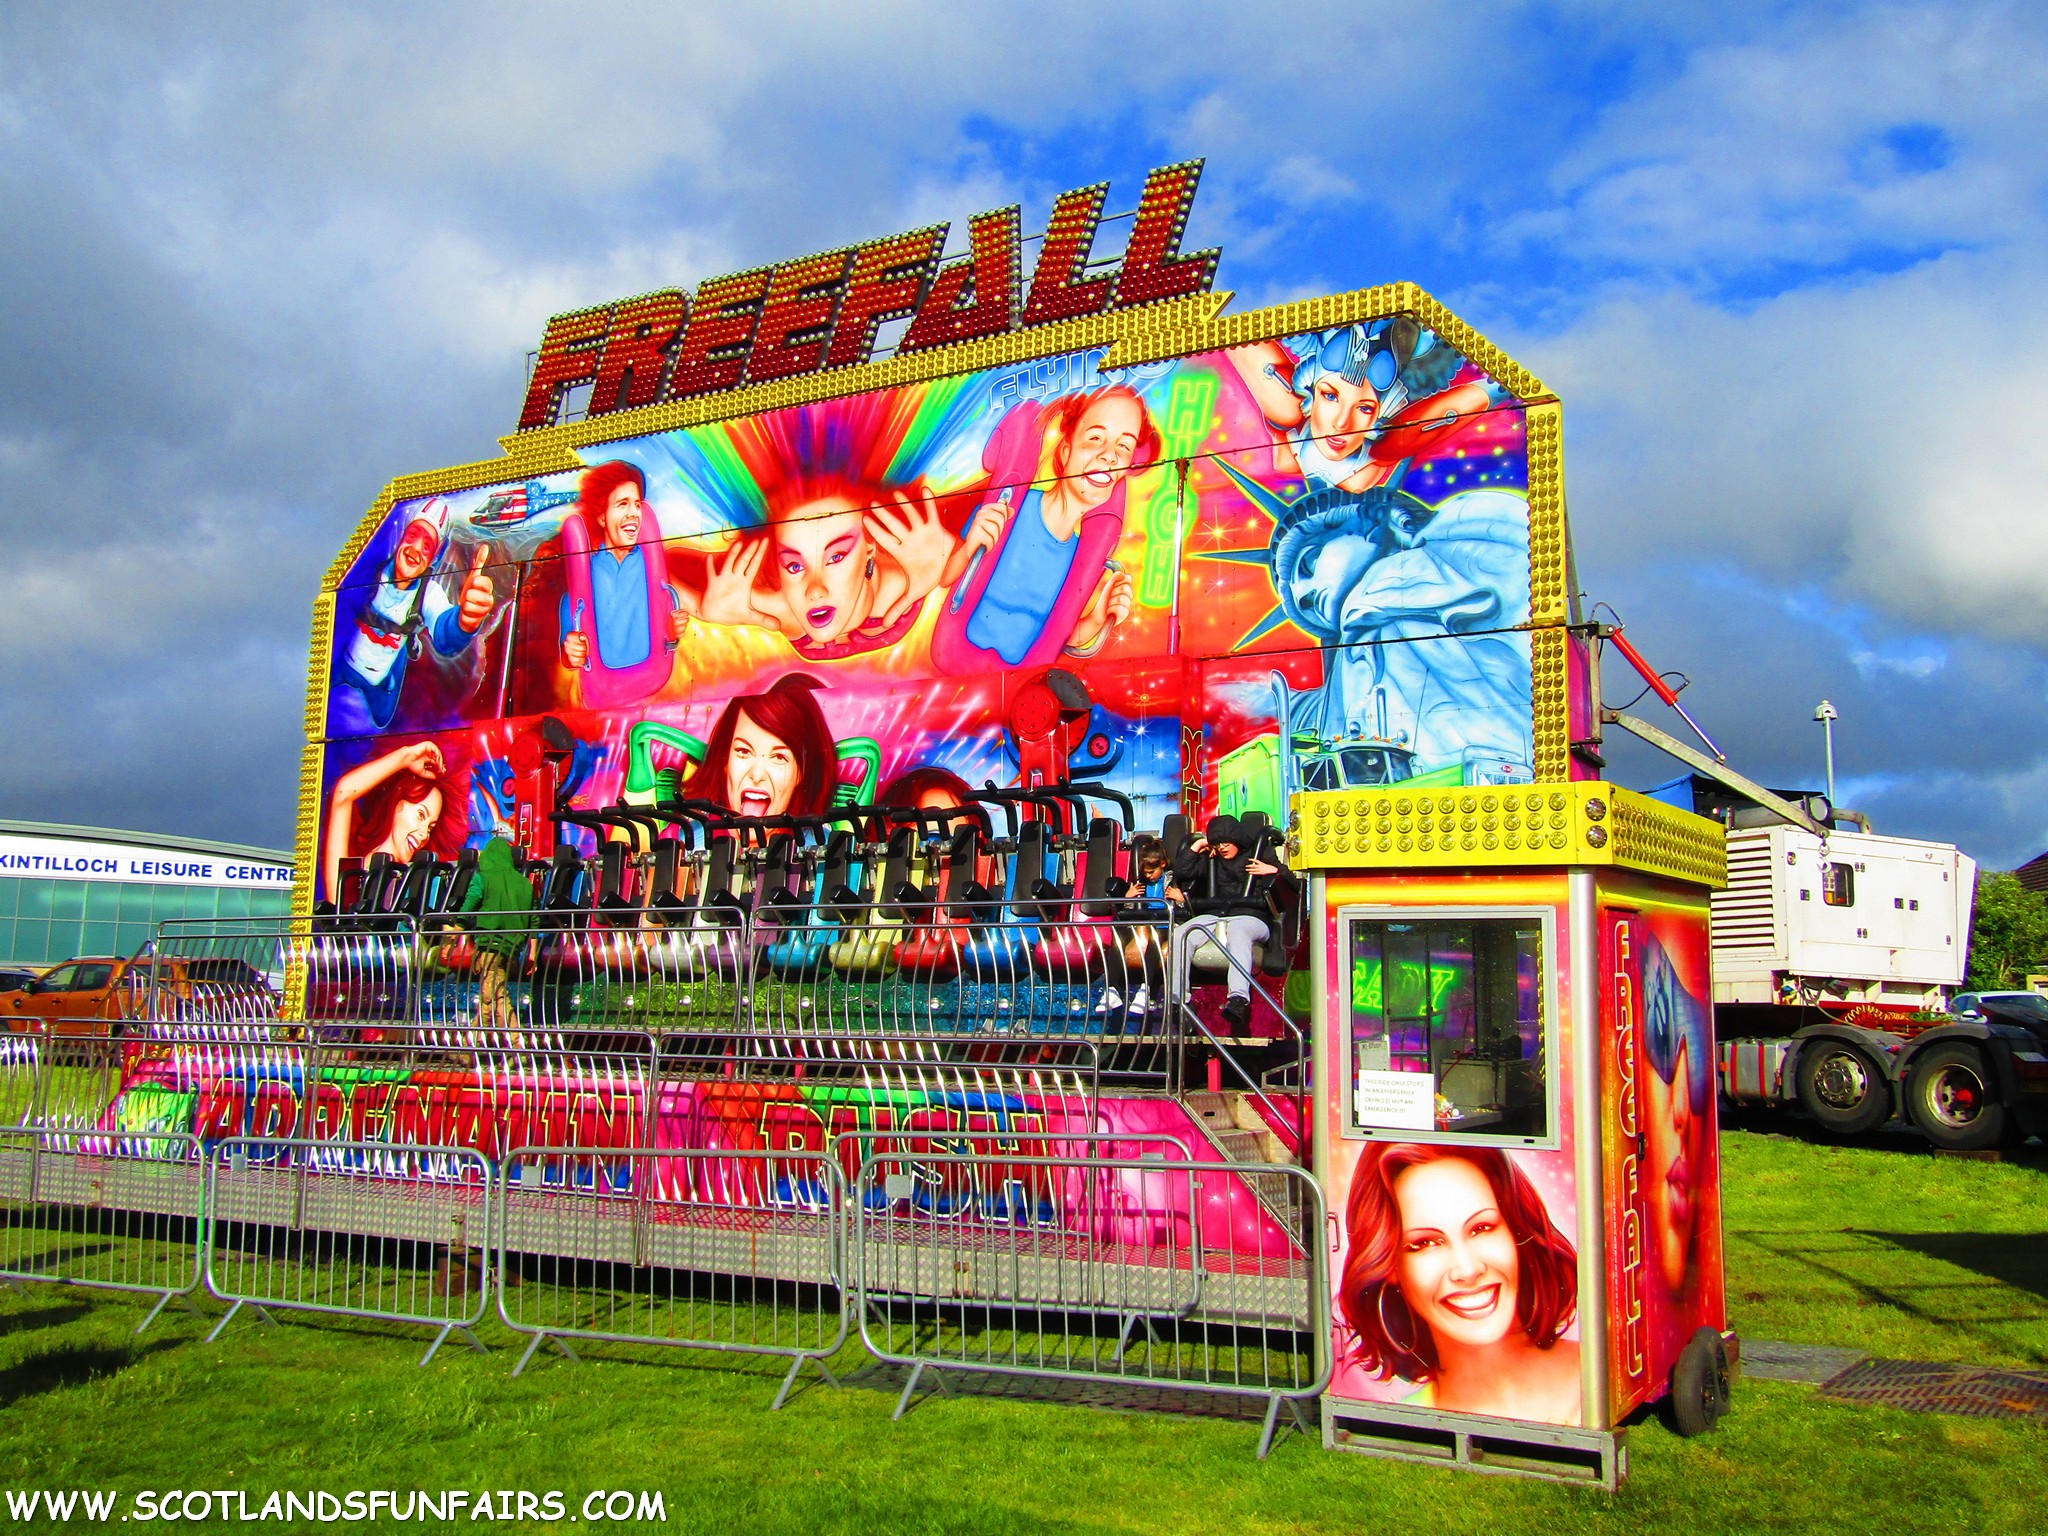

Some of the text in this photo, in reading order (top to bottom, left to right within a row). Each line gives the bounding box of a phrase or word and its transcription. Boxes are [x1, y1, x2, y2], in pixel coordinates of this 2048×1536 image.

[514, 156, 1222, 433] FREEFALL
[1145, 381, 1213, 600] HIGH
[130, 861, 213, 878] LEISURE
[225, 865, 297, 882] CENTRE
[760, 1101, 1060, 1227] RUSH
[1613, 920, 1643, 1378] FREE FALL
